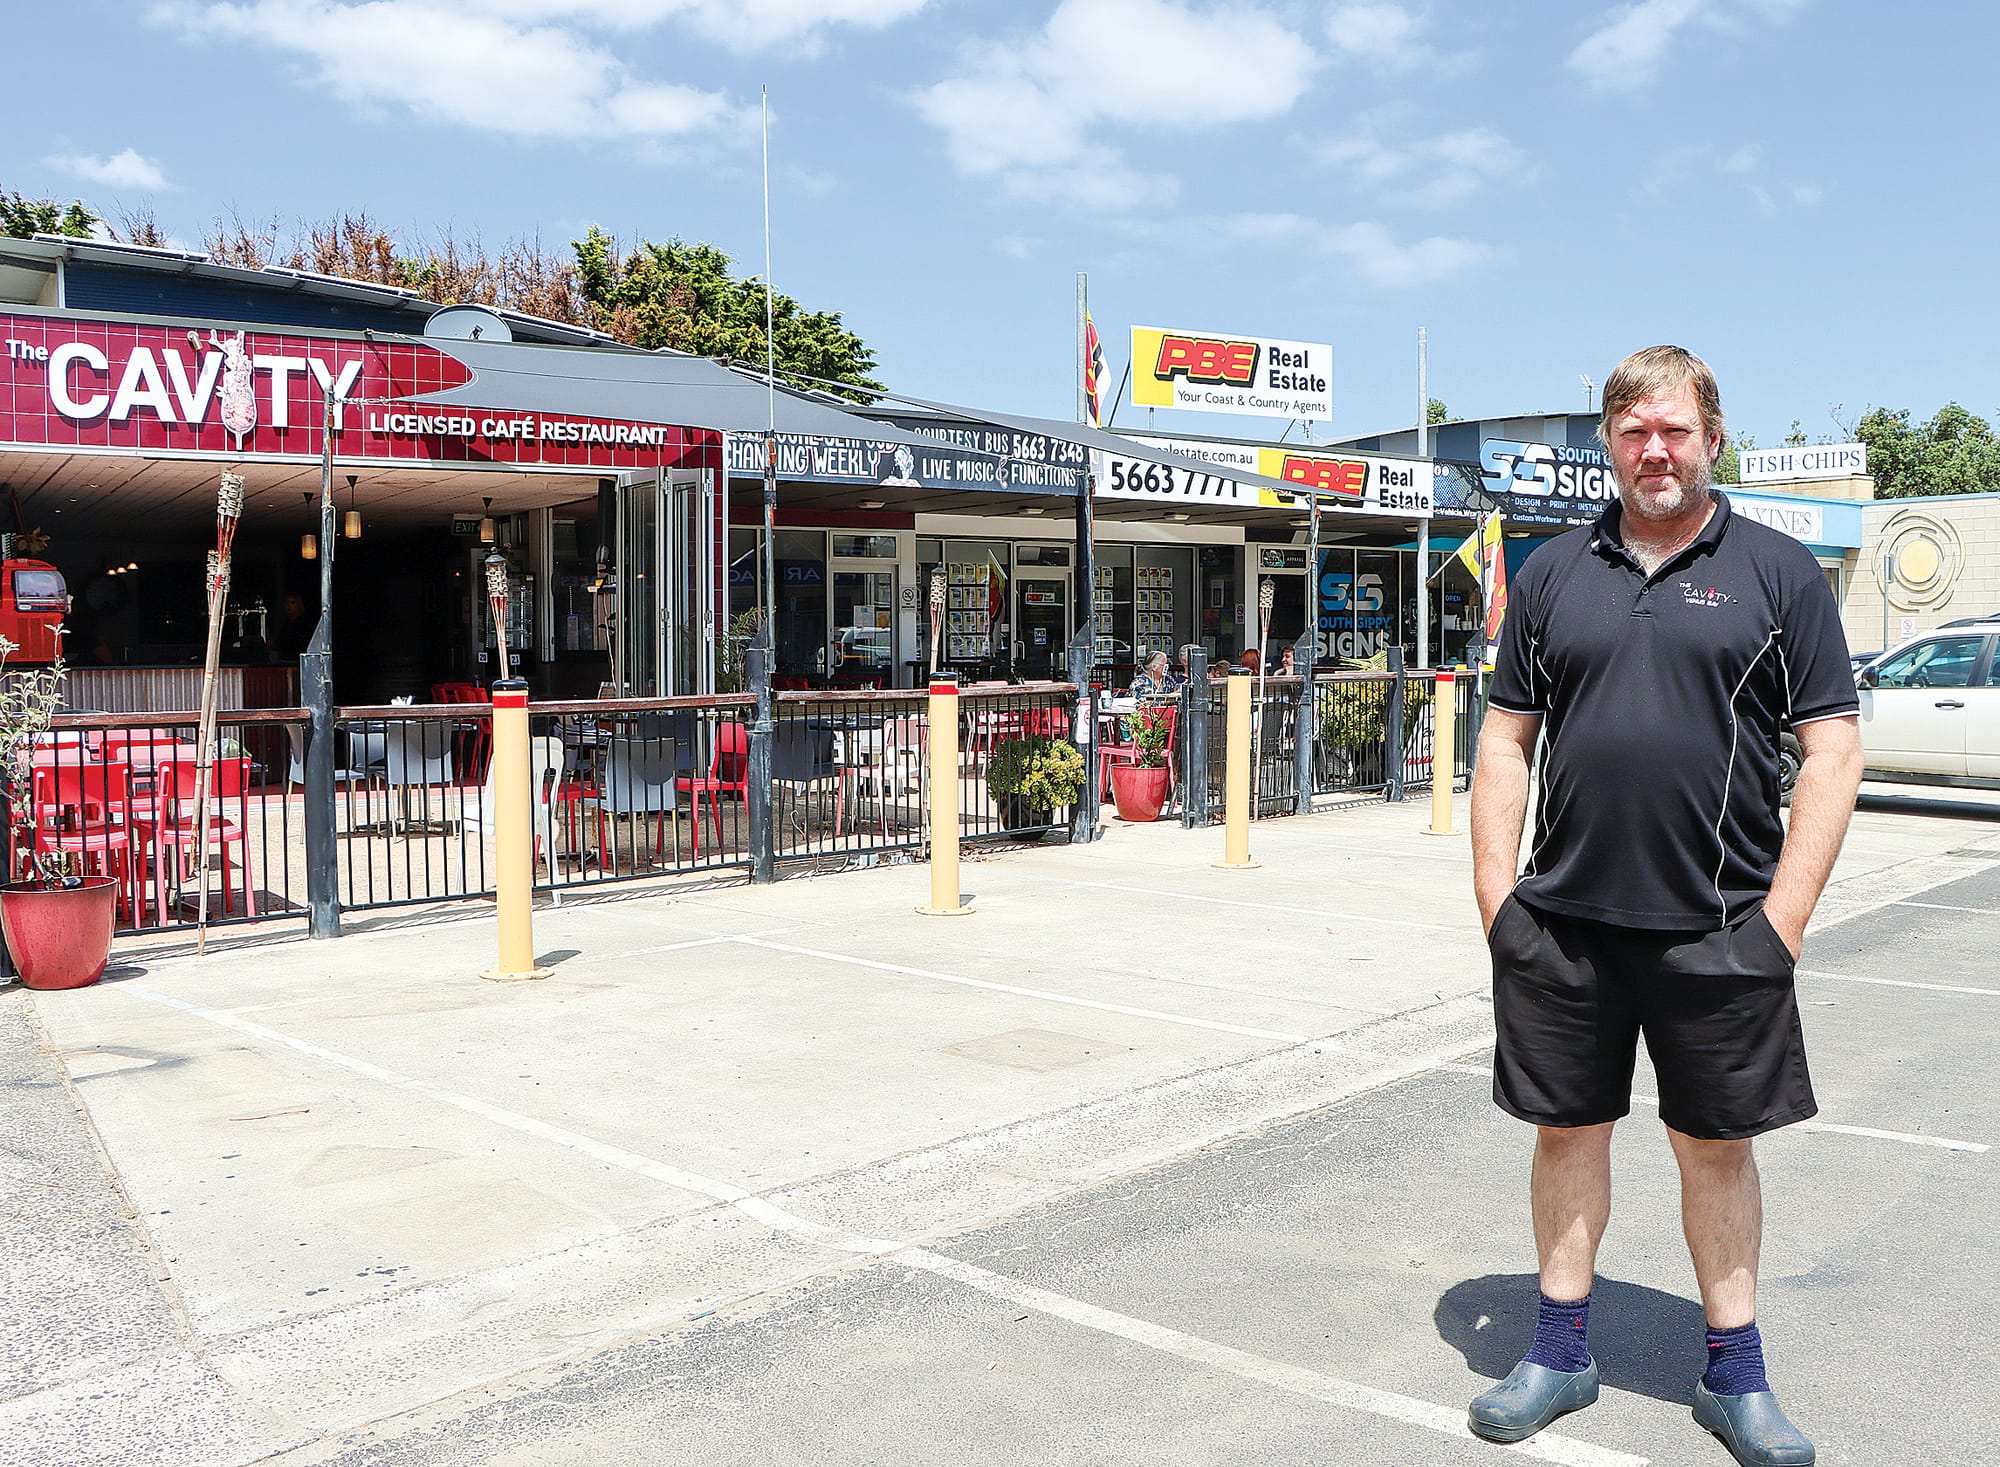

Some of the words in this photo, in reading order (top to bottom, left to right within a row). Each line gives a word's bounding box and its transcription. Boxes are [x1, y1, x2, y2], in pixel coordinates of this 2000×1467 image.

[6, 339, 48, 361] The
[1269, 347, 1308, 369] Real
[1155, 335, 1260, 388] PBE
[1269, 370, 1326, 392] Estate
[1178, 390, 1202, 404] Your
[1205, 394, 1234, 406] Coast
[1238, 395, 1246, 406] &
[1249, 396, 1289, 412] Country
[1292, 398, 1326, 413] Agents
[370, 412, 476, 435] LICENSED
[481, 415, 534, 439] CAFÉ
[540, 421, 667, 445] RESTAURANT
[727, 440, 807, 472] HANING
[813, 446, 879, 475] WEEKLY
[985, 431, 1009, 453] BUS
[1013, 434, 1046, 460] 5663
[1051, 437, 1084, 463] 7348
[1158, 444, 1253, 464] alestate.com.au
[1557, 447, 1600, 465] SOUTH
[922, 458, 951, 481] LIVE
[956, 460, 994, 483] MUSIC
[1011, 464, 1077, 487] FUNCTIONS
[1746, 455, 1793, 473] FISH
[1802, 450, 1860, 470] CHIPS
[1111, 461, 1175, 493] 5663
[1379, 465, 1413, 486] Real
[1557, 465, 1620, 500] SIGN
[1379, 488, 1429, 510] Estate
[1514, 497, 1541, 507] DESIGN
[1550, 500, 1569, 510] PRINT
[1578, 502, 1604, 513] INSTALL
[455, 522, 475, 533] EXIT
[1512, 513, 1533, 522] Custom
[1534, 514, 1562, 524] Workwear
[1566, 517, 1580, 527] Shop
[1732, 506, 1811, 534] XINES
[1319, 617, 1352, 629] OUTH
[1358, 617, 1391, 630] GIPPY
[1316, 631, 1391, 658] SIGNS
